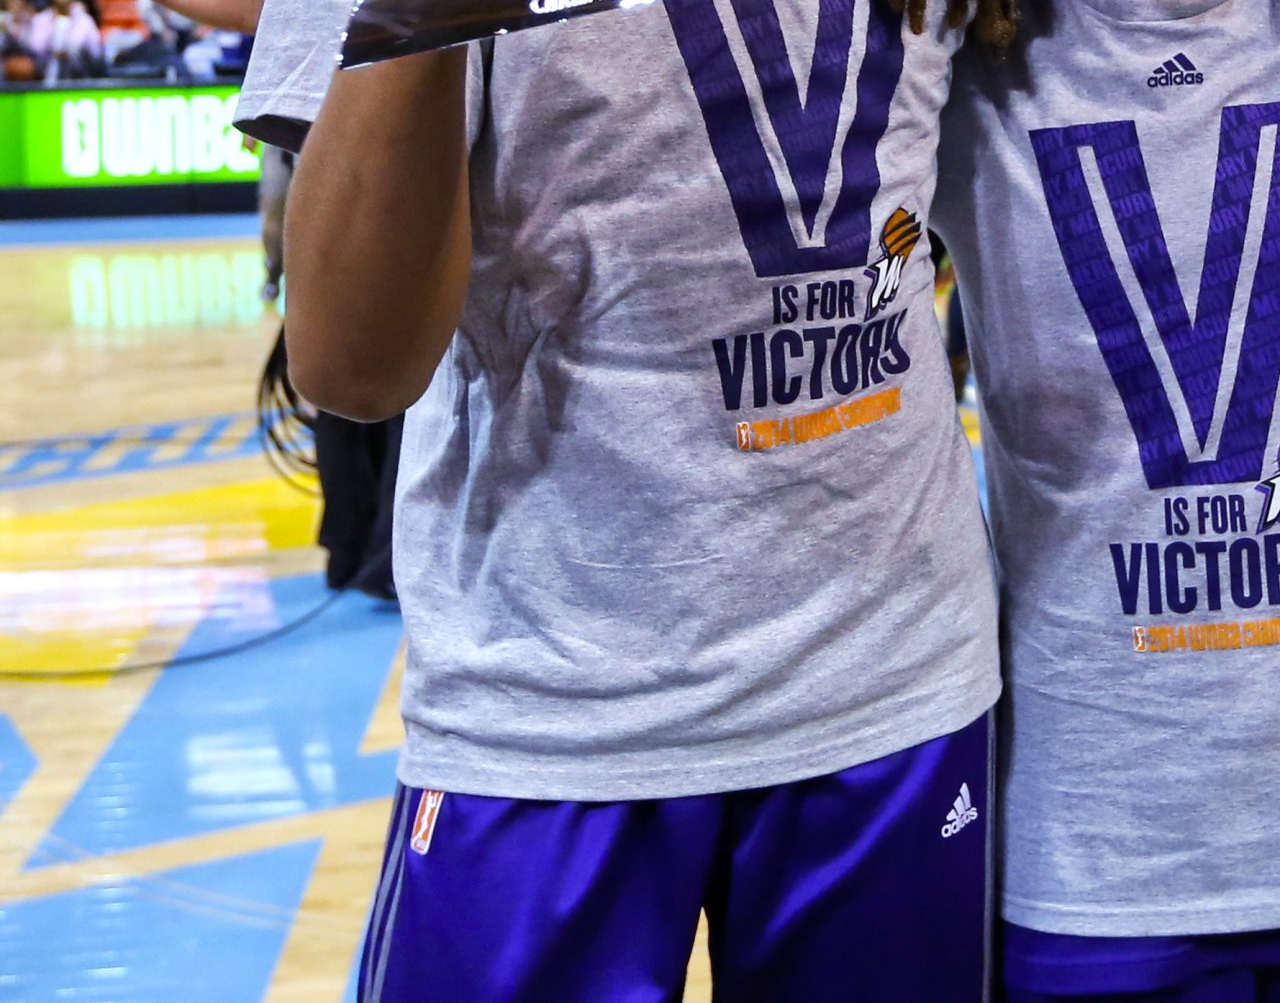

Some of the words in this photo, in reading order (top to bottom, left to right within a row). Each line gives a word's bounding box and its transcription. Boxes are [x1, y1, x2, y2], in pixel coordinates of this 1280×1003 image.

[1147, 70, 1204, 88] adidas
[772, 285, 799, 324] IS
[806, 280, 856, 321] FOR
[712, 307, 911, 411] VICTORY
[751, 418, 791, 451] 2014
[1164, 497, 1190, 536] IS
[1197, 494, 1247, 535] FOR
[1147, 626, 1187, 652] 2014
[941, 796, 979, 838] adidas
